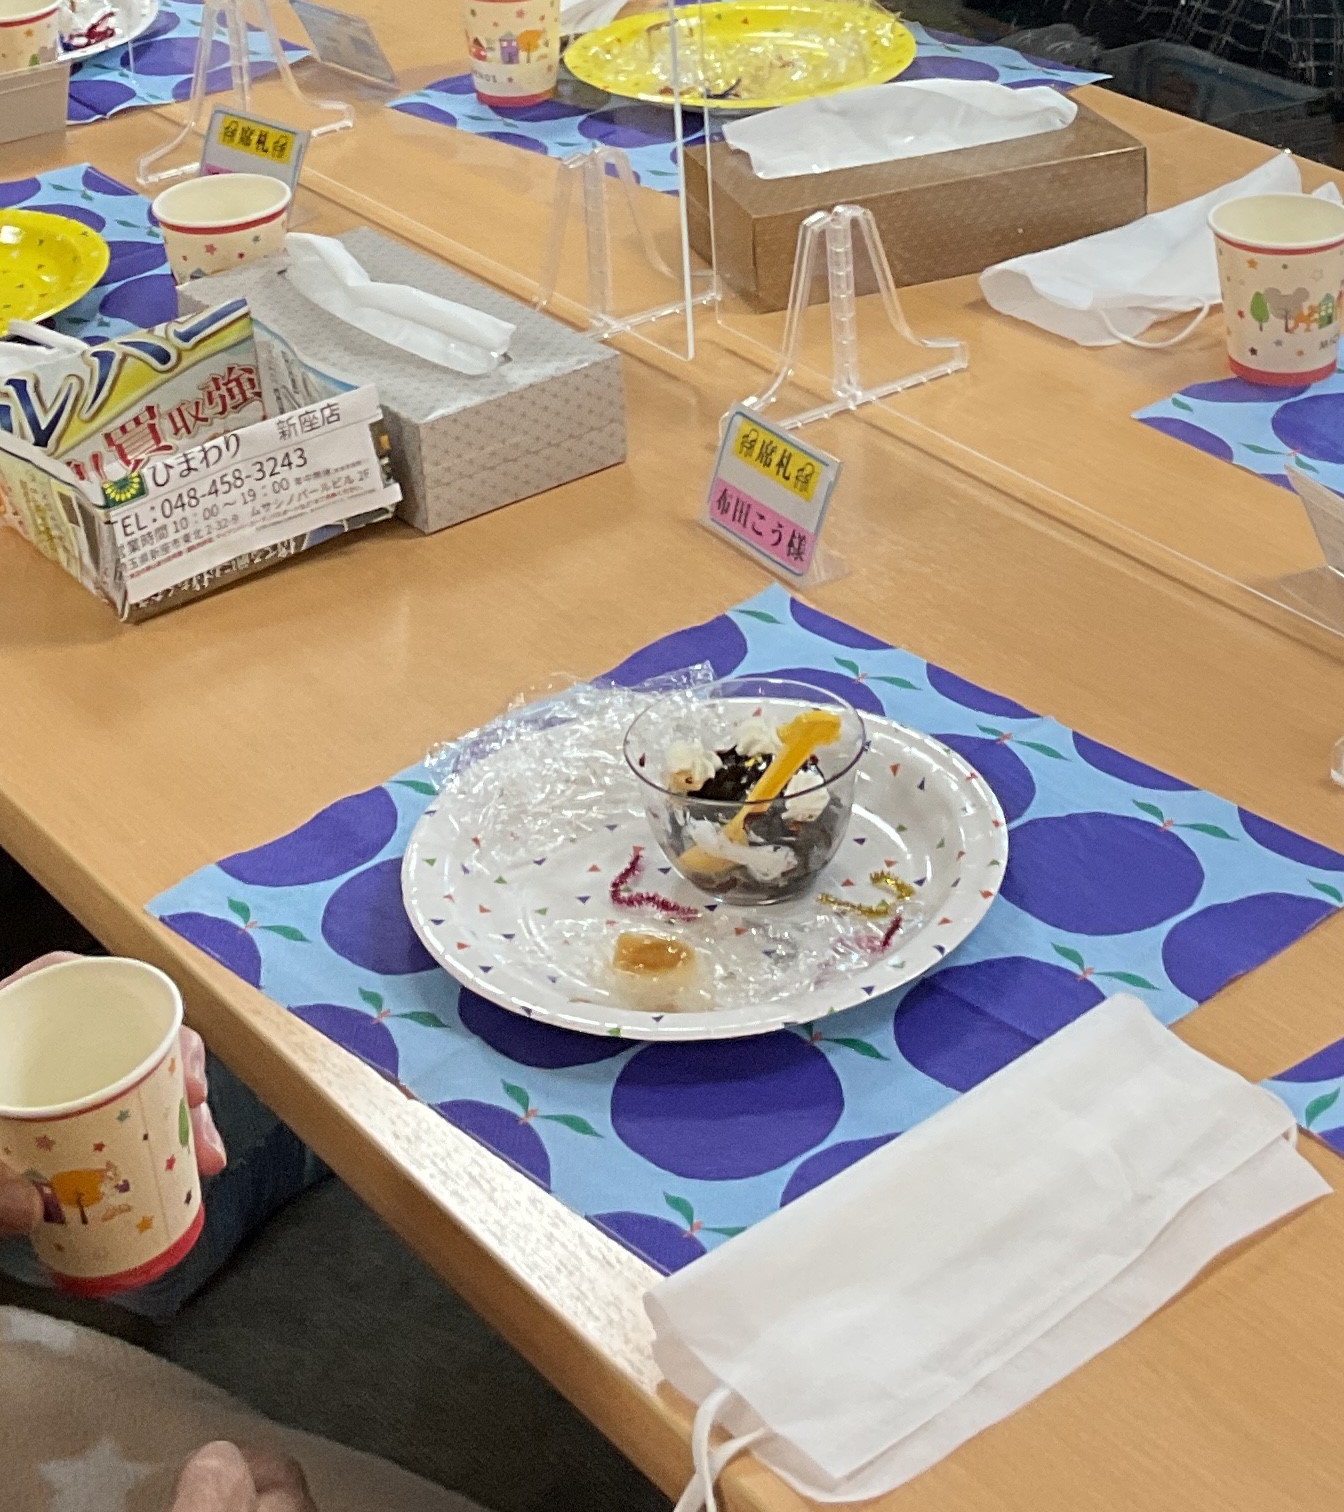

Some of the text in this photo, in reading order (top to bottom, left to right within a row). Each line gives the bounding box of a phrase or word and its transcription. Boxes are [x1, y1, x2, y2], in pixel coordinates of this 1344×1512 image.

[149, 402, 341, 488] ひまわり 新座店
